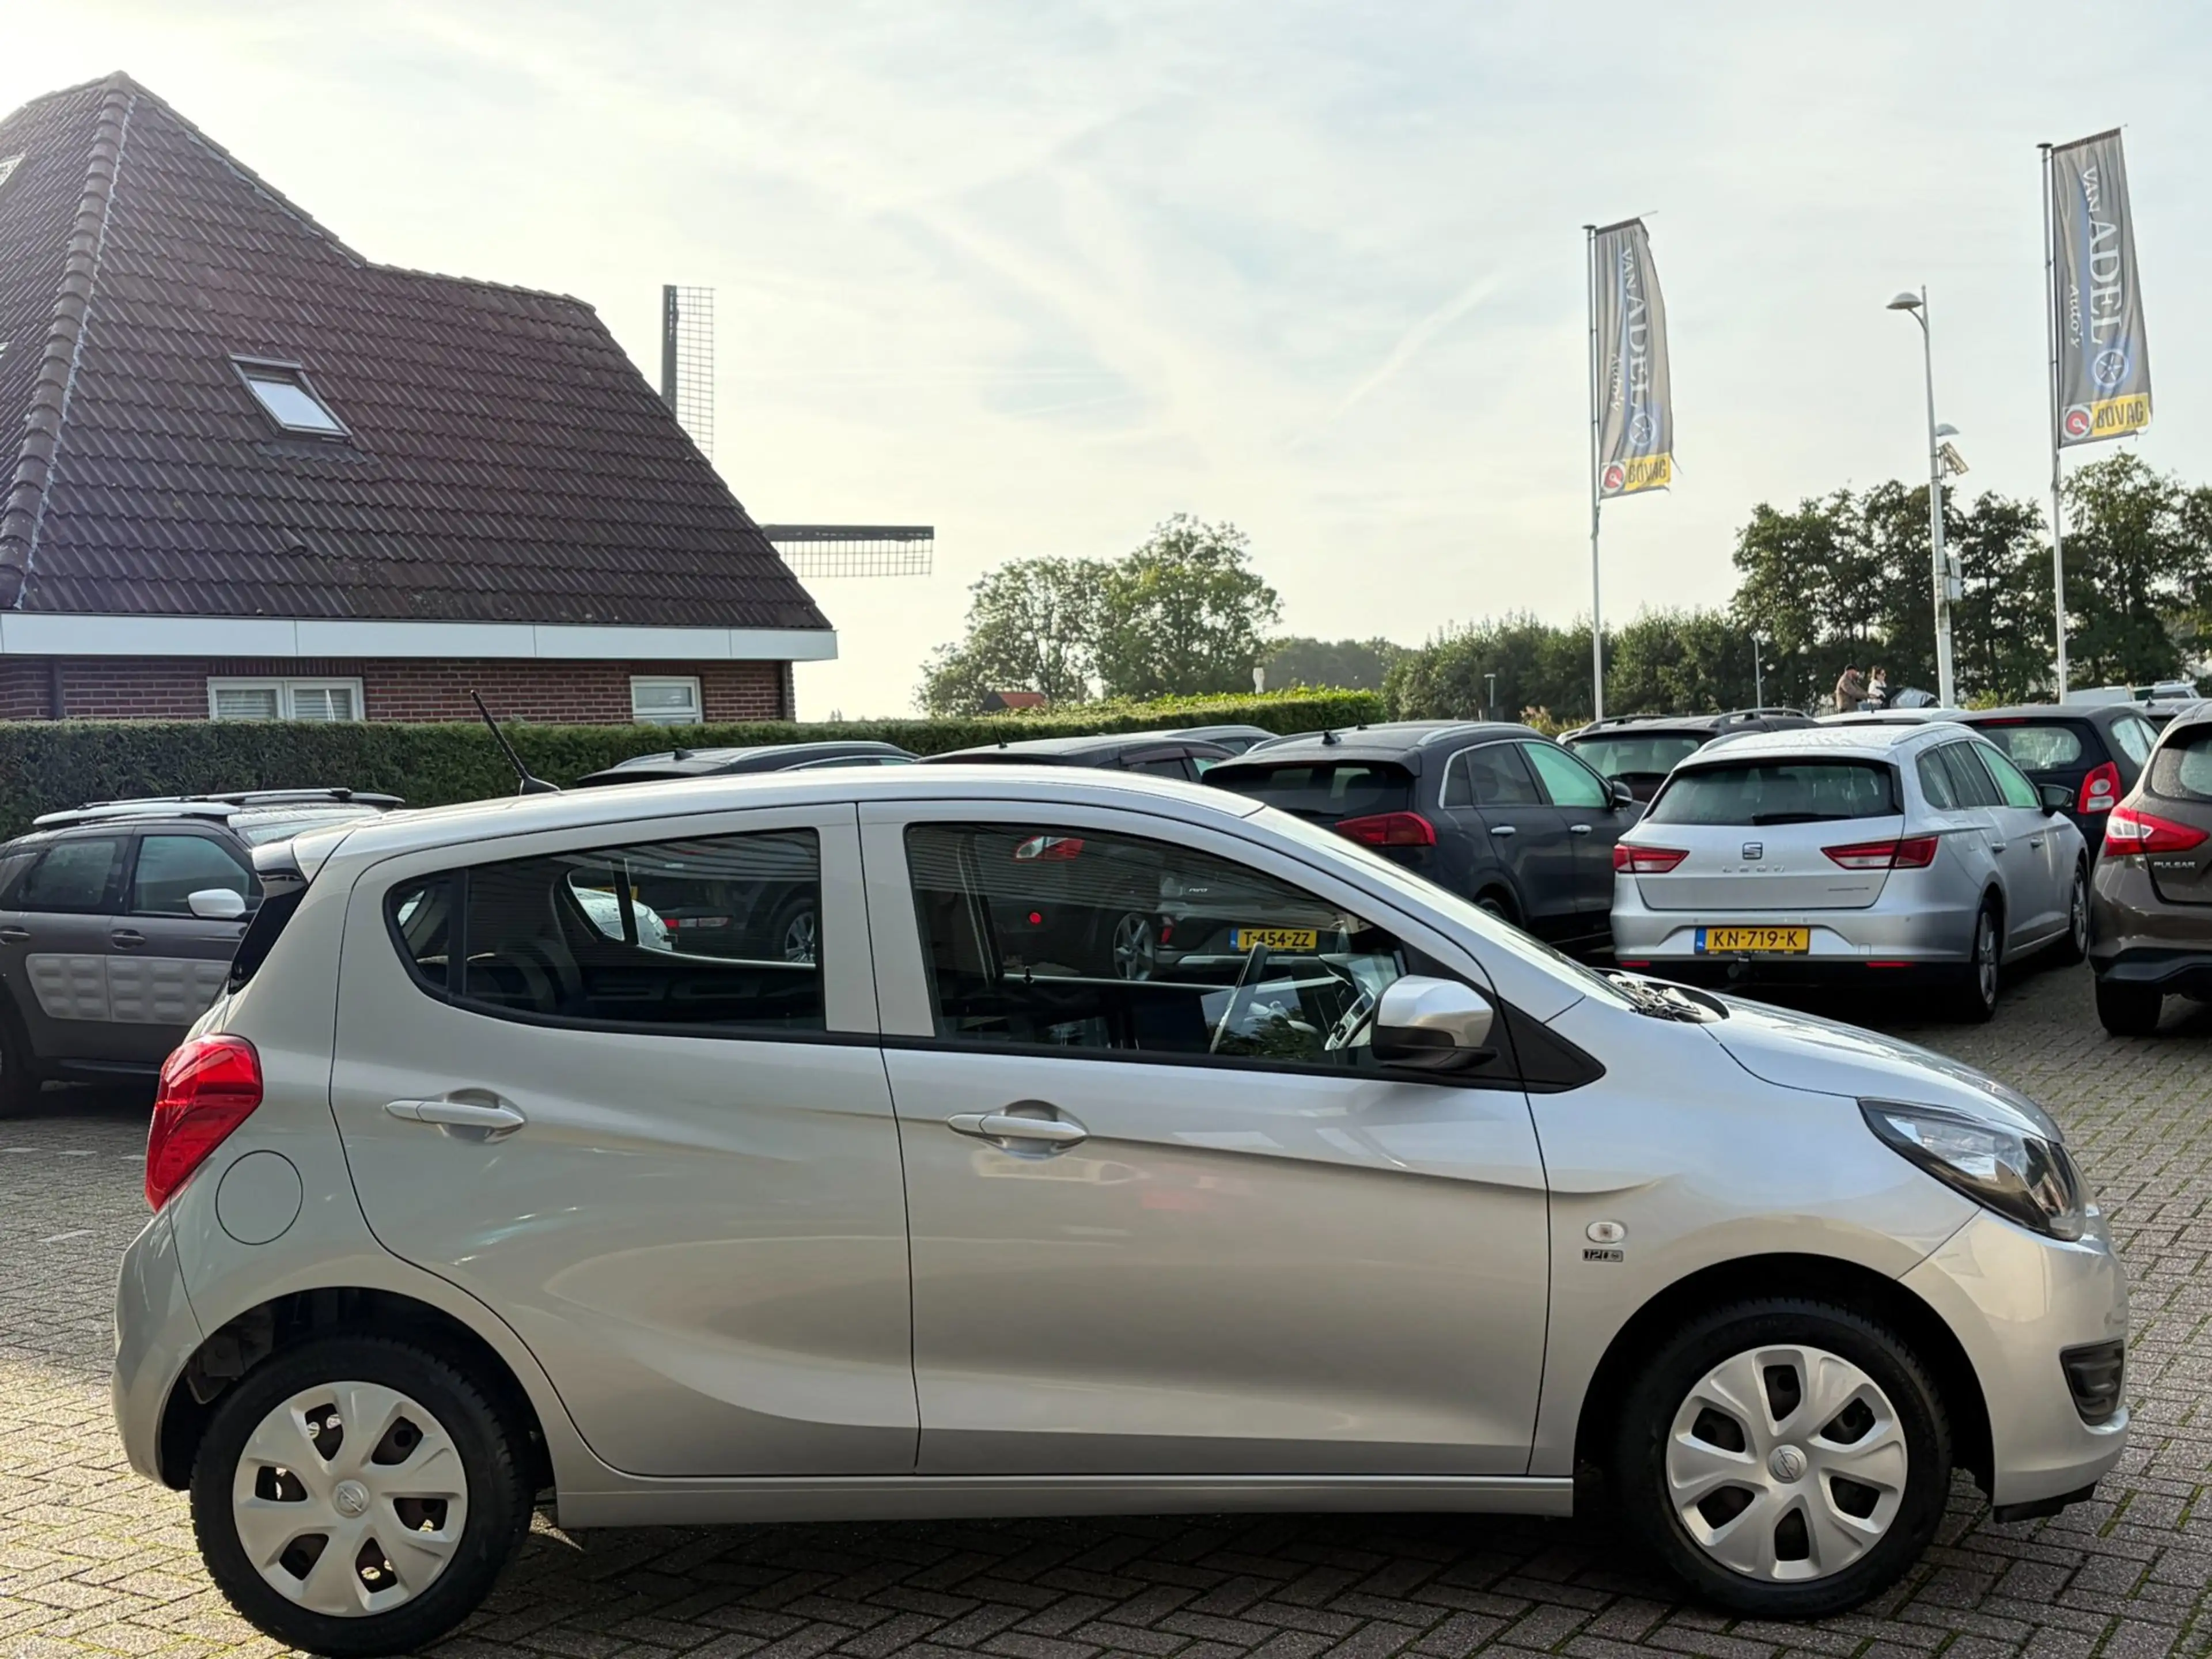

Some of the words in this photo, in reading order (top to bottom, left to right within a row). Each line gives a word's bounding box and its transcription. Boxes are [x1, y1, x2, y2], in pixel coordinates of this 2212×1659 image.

[2082, 165, 2101, 213] VAN
[1622, 246, 1637, 289] VAN
[2089, 221, 2123, 344] ADEL
[1626, 293, 1649, 408] ADEL
[2096, 400, 2144, 429] BOVAG
[1628, 459, 1666, 483] BOVAG
[1244, 931, 1310, 946] T-454-ZZ
[1713, 930, 1798, 947] KN-719-K
